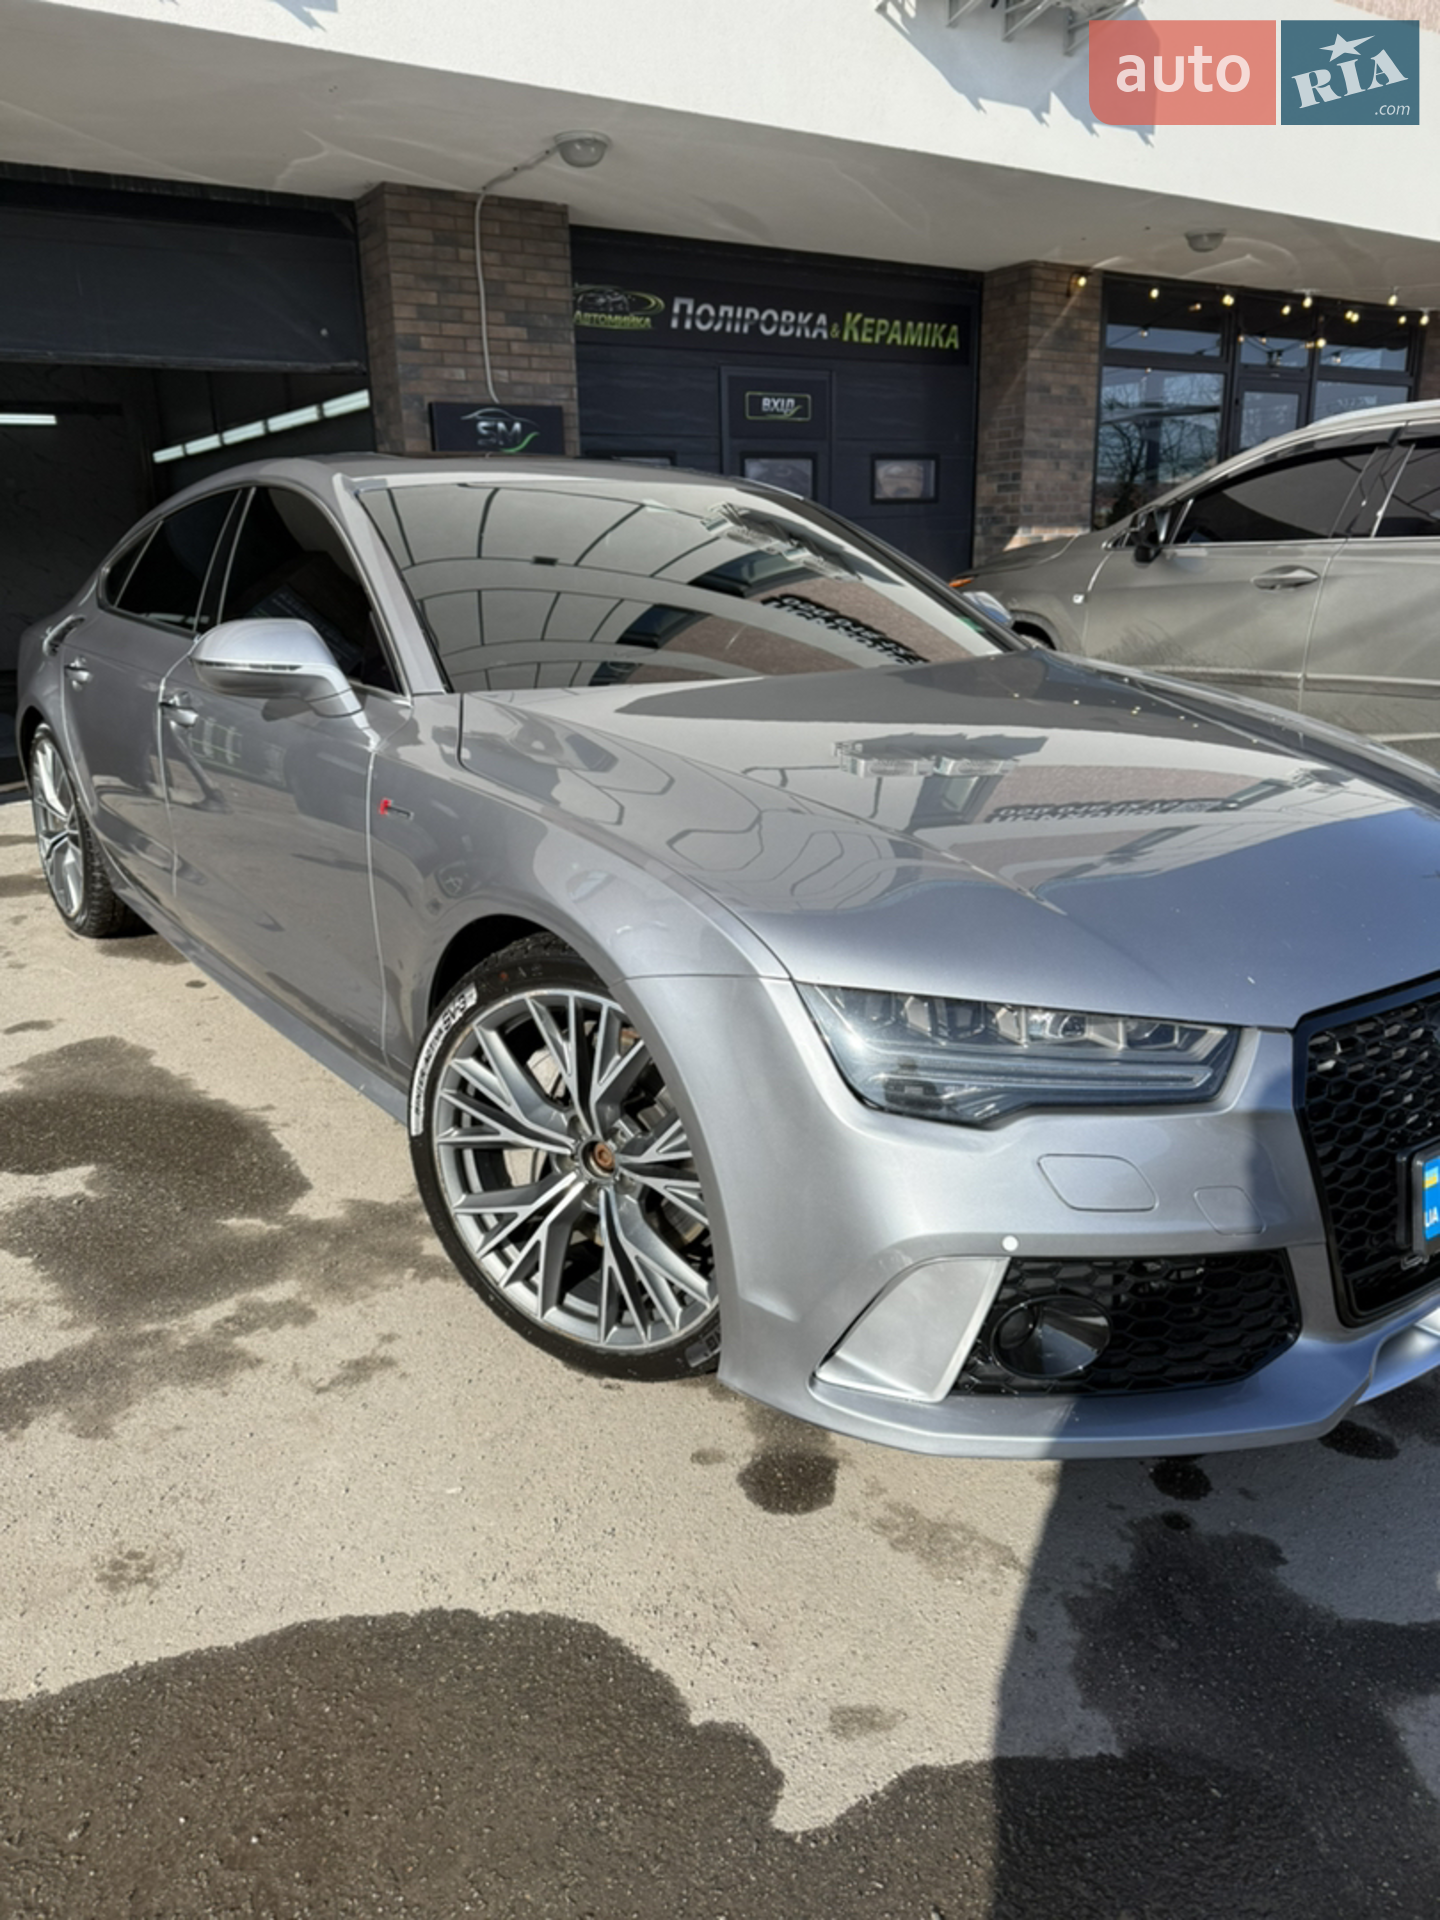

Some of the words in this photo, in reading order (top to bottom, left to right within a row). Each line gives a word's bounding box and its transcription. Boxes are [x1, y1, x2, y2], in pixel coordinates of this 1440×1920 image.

[671, 297, 829, 340] ПОЛІРОВКА
[829, 322, 841, 338] &
[843, 312, 960, 348] КЕРАМІКА
